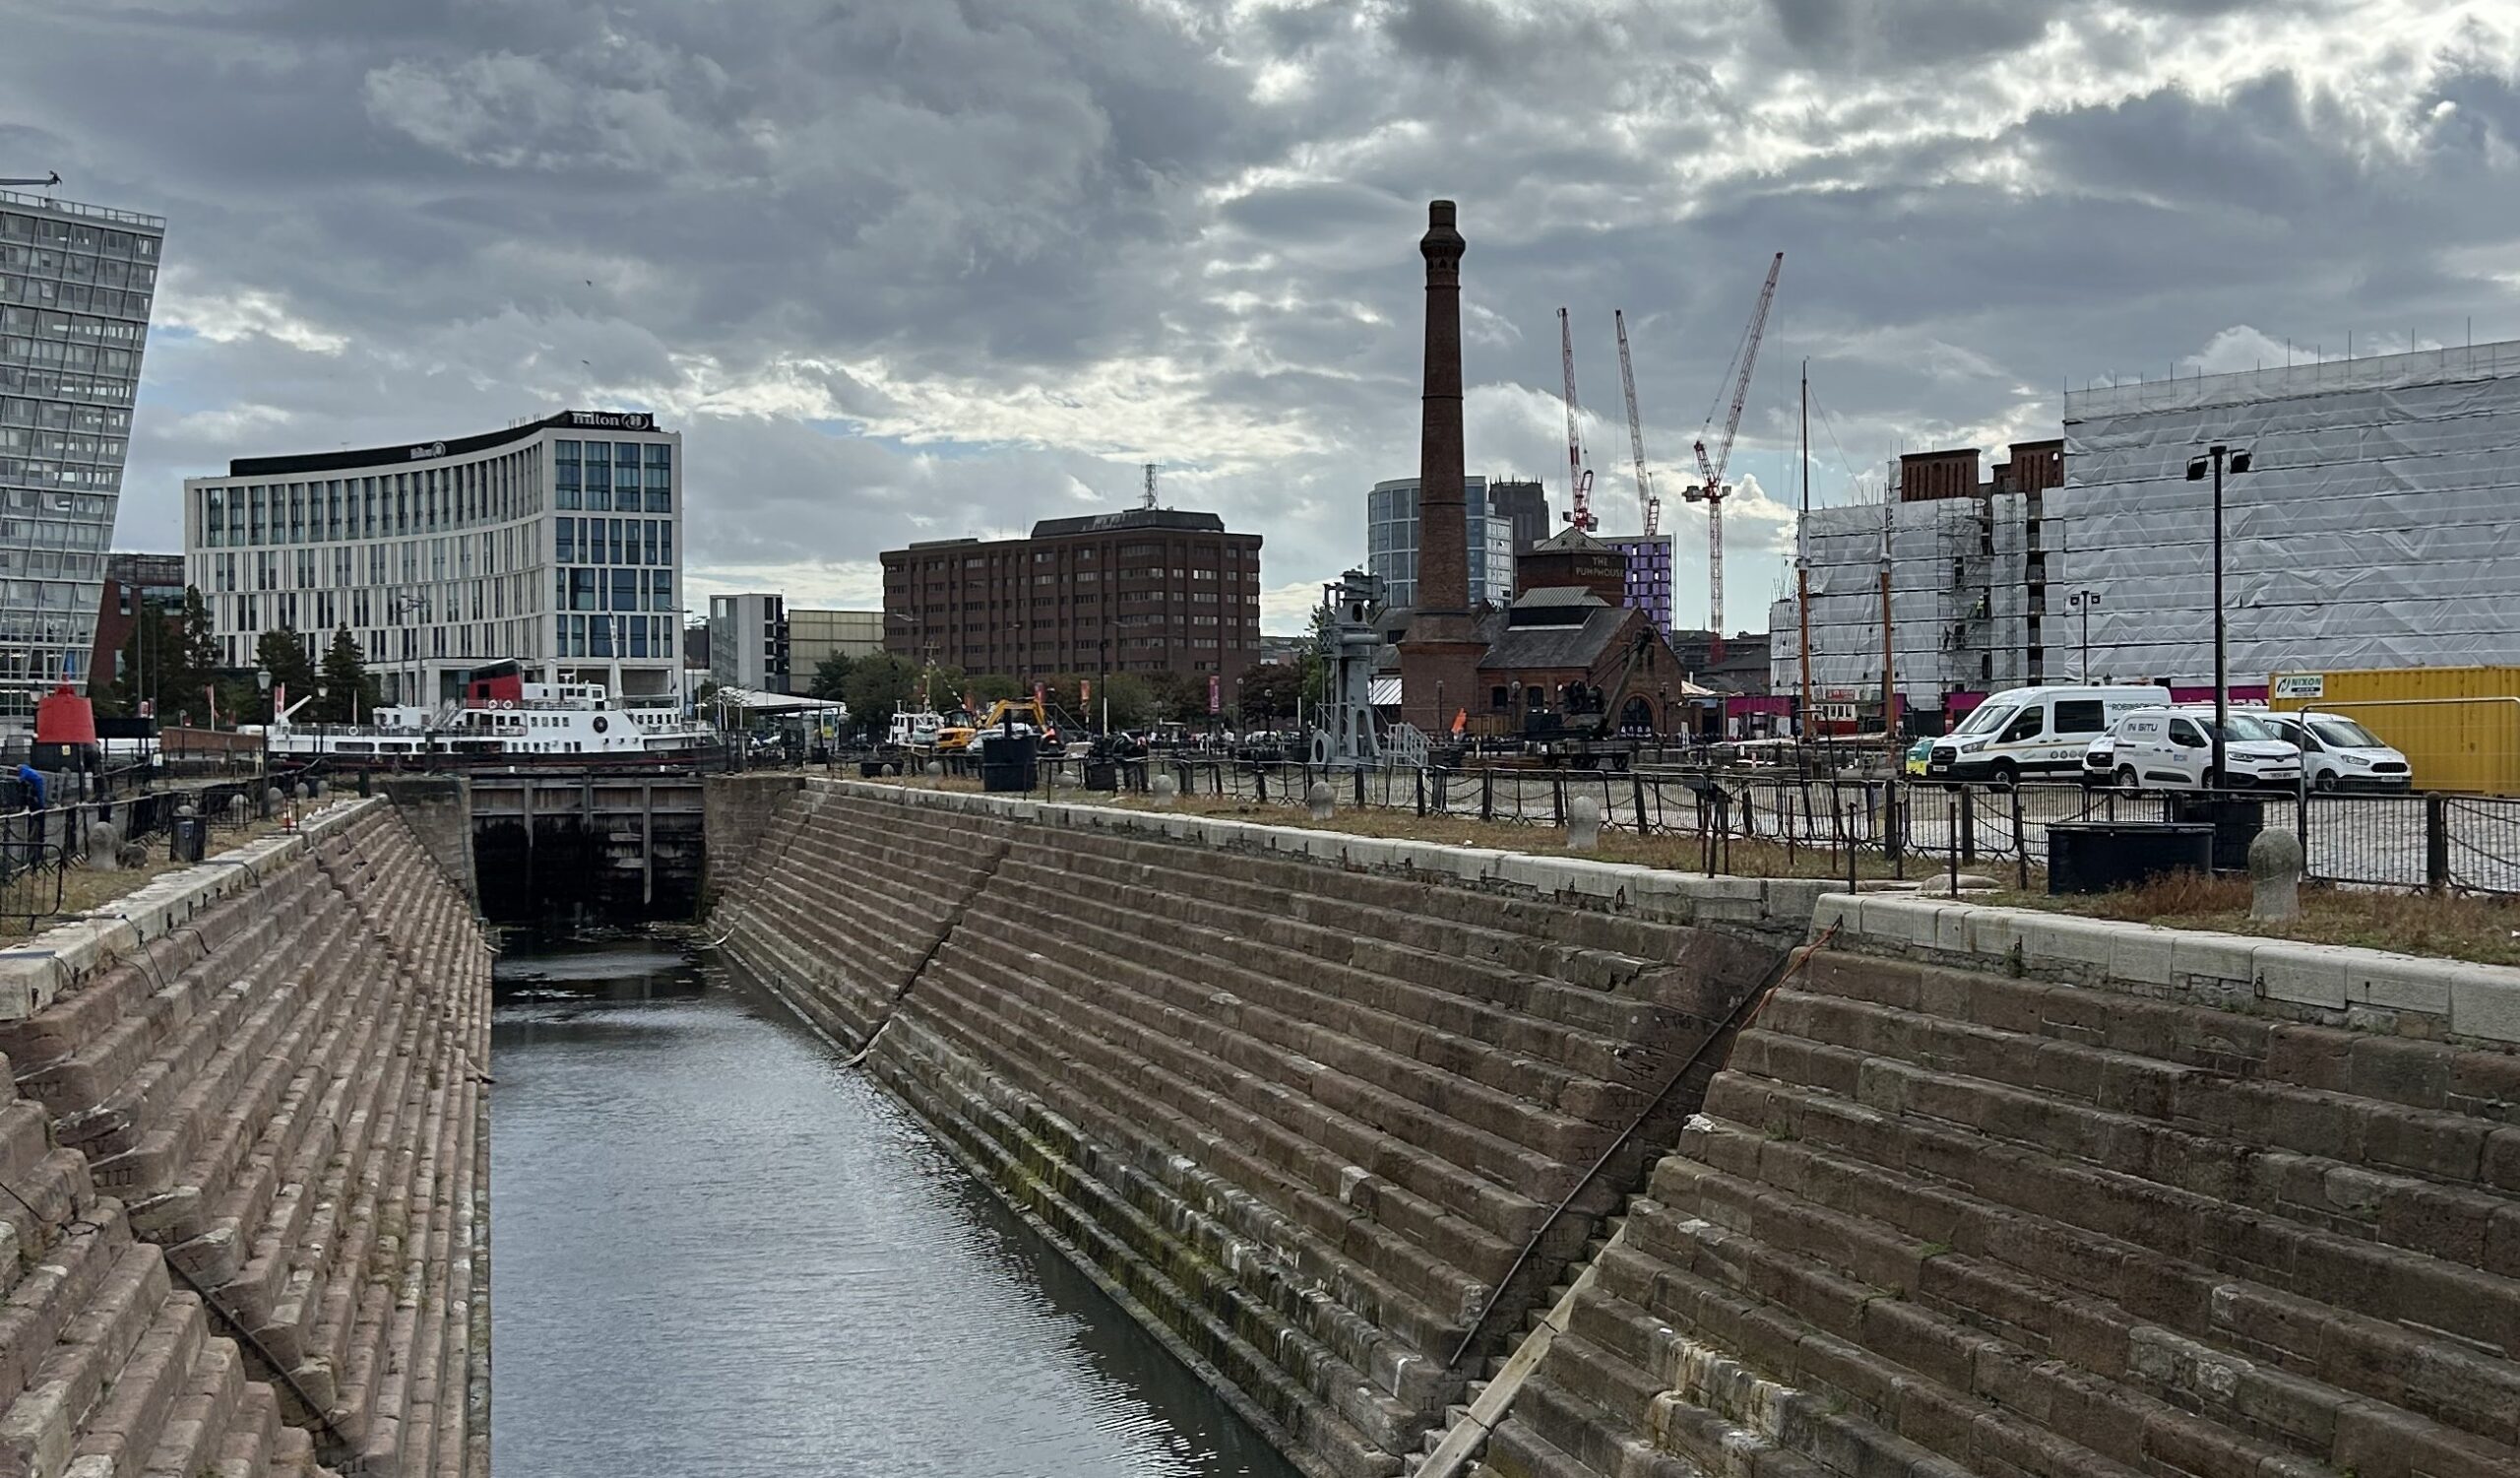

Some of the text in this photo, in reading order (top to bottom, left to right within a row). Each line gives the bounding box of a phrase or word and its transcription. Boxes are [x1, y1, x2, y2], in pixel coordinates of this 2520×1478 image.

[1592, 557, 1608, 566] THE
[1575, 567, 1625, 577] PUMPHOUSE
[2291, 677, 2322, 686] NIXON
